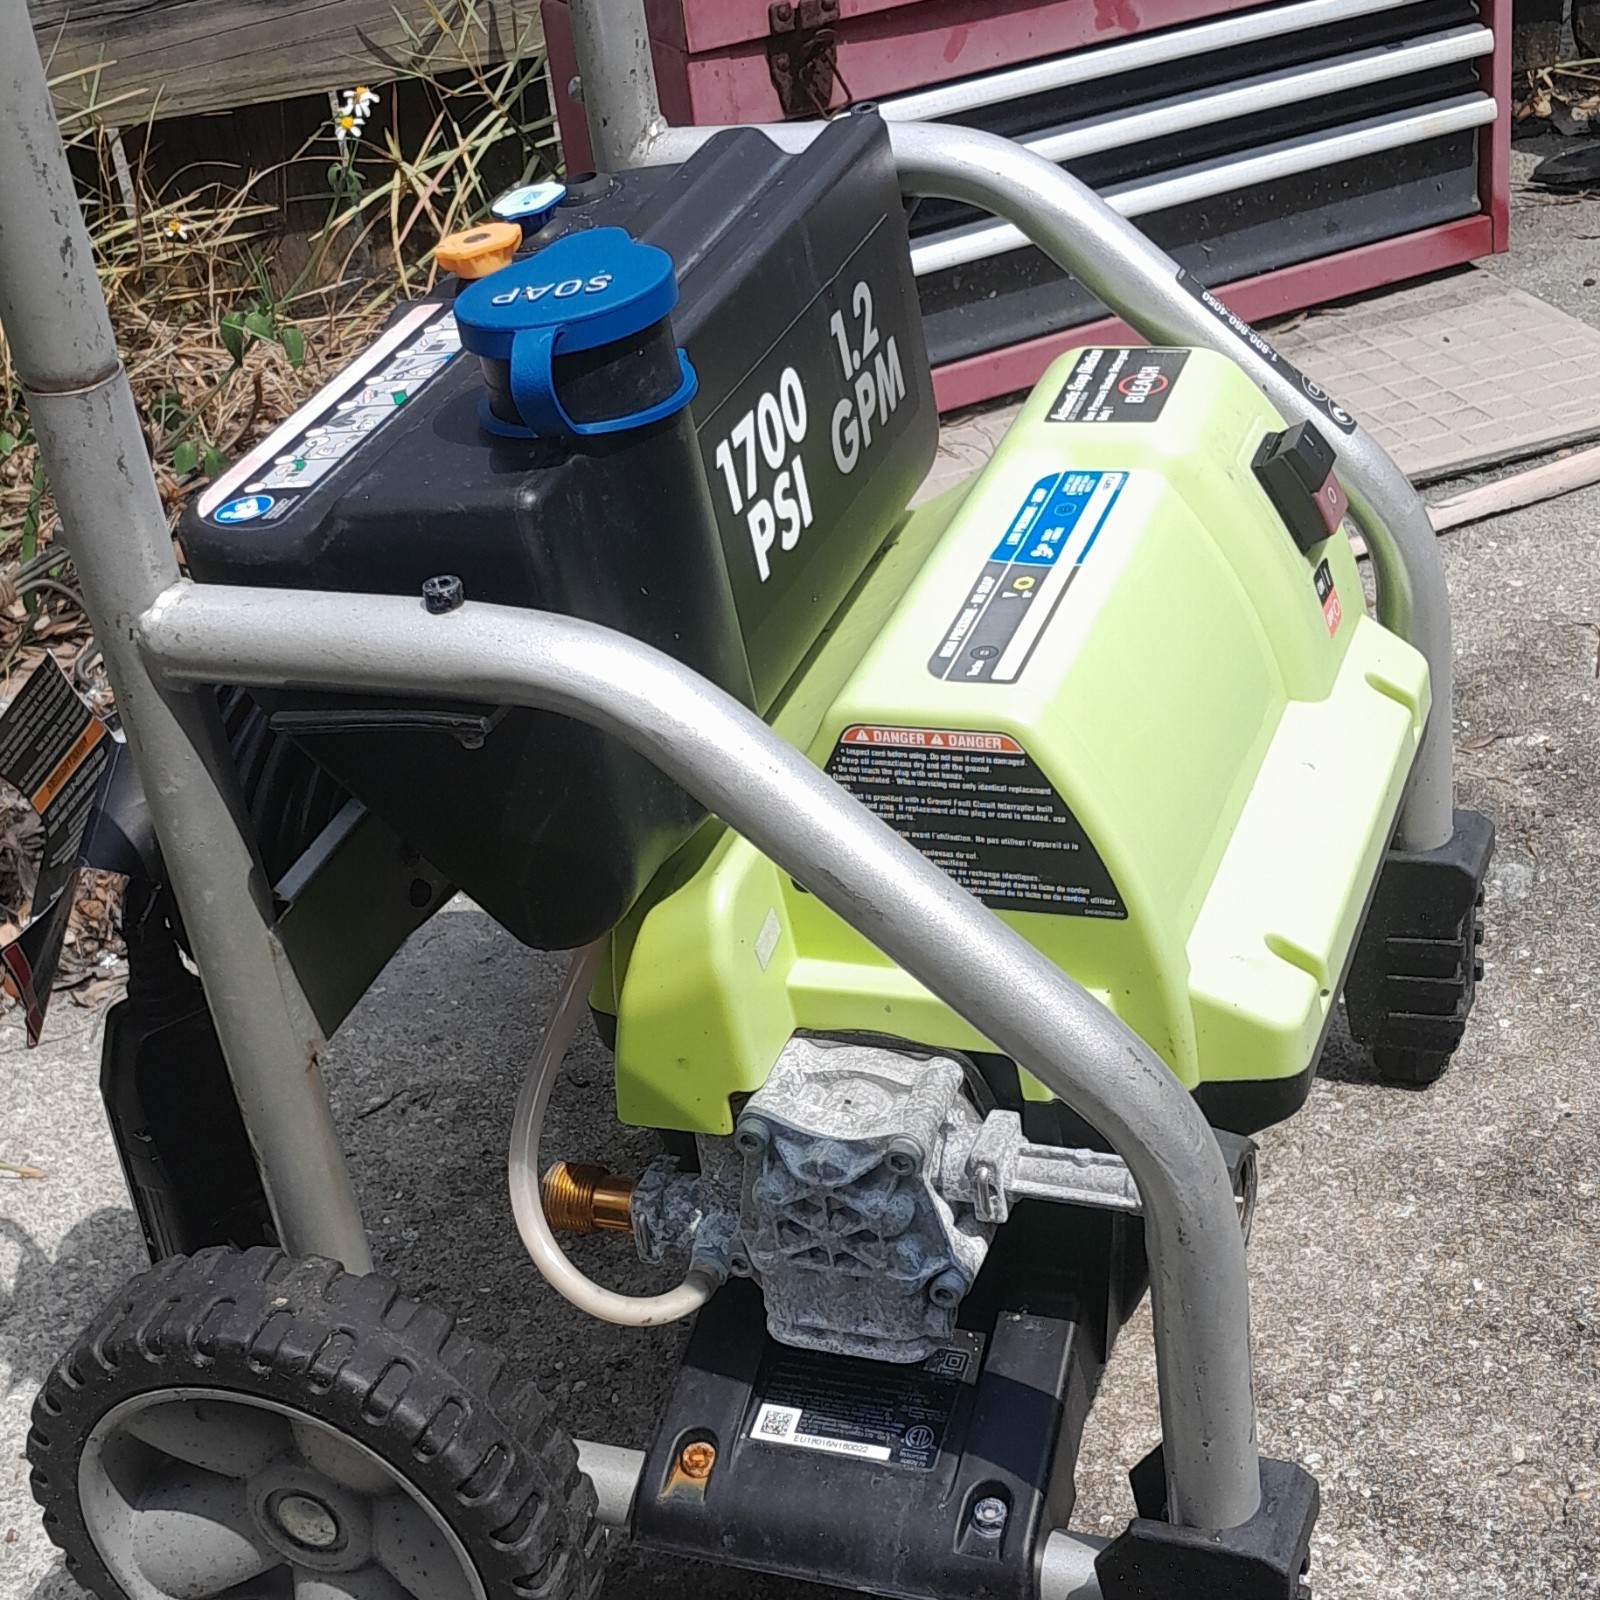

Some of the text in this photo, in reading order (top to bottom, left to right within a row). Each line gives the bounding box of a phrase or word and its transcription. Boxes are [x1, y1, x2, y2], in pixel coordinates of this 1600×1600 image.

[492, 274, 614, 306] SOAP
[830, 281, 880, 381] 1.2
[1202, 291, 1278, 362] 1-800-860-4050
[832, 336, 906, 475] GPM
[1124, 366, 1161, 403] BLEACH
[716, 367, 807, 515] 1700
[747, 455, 813, 582] PSI
[872, 730, 1002, 749] DANGER DANGER
